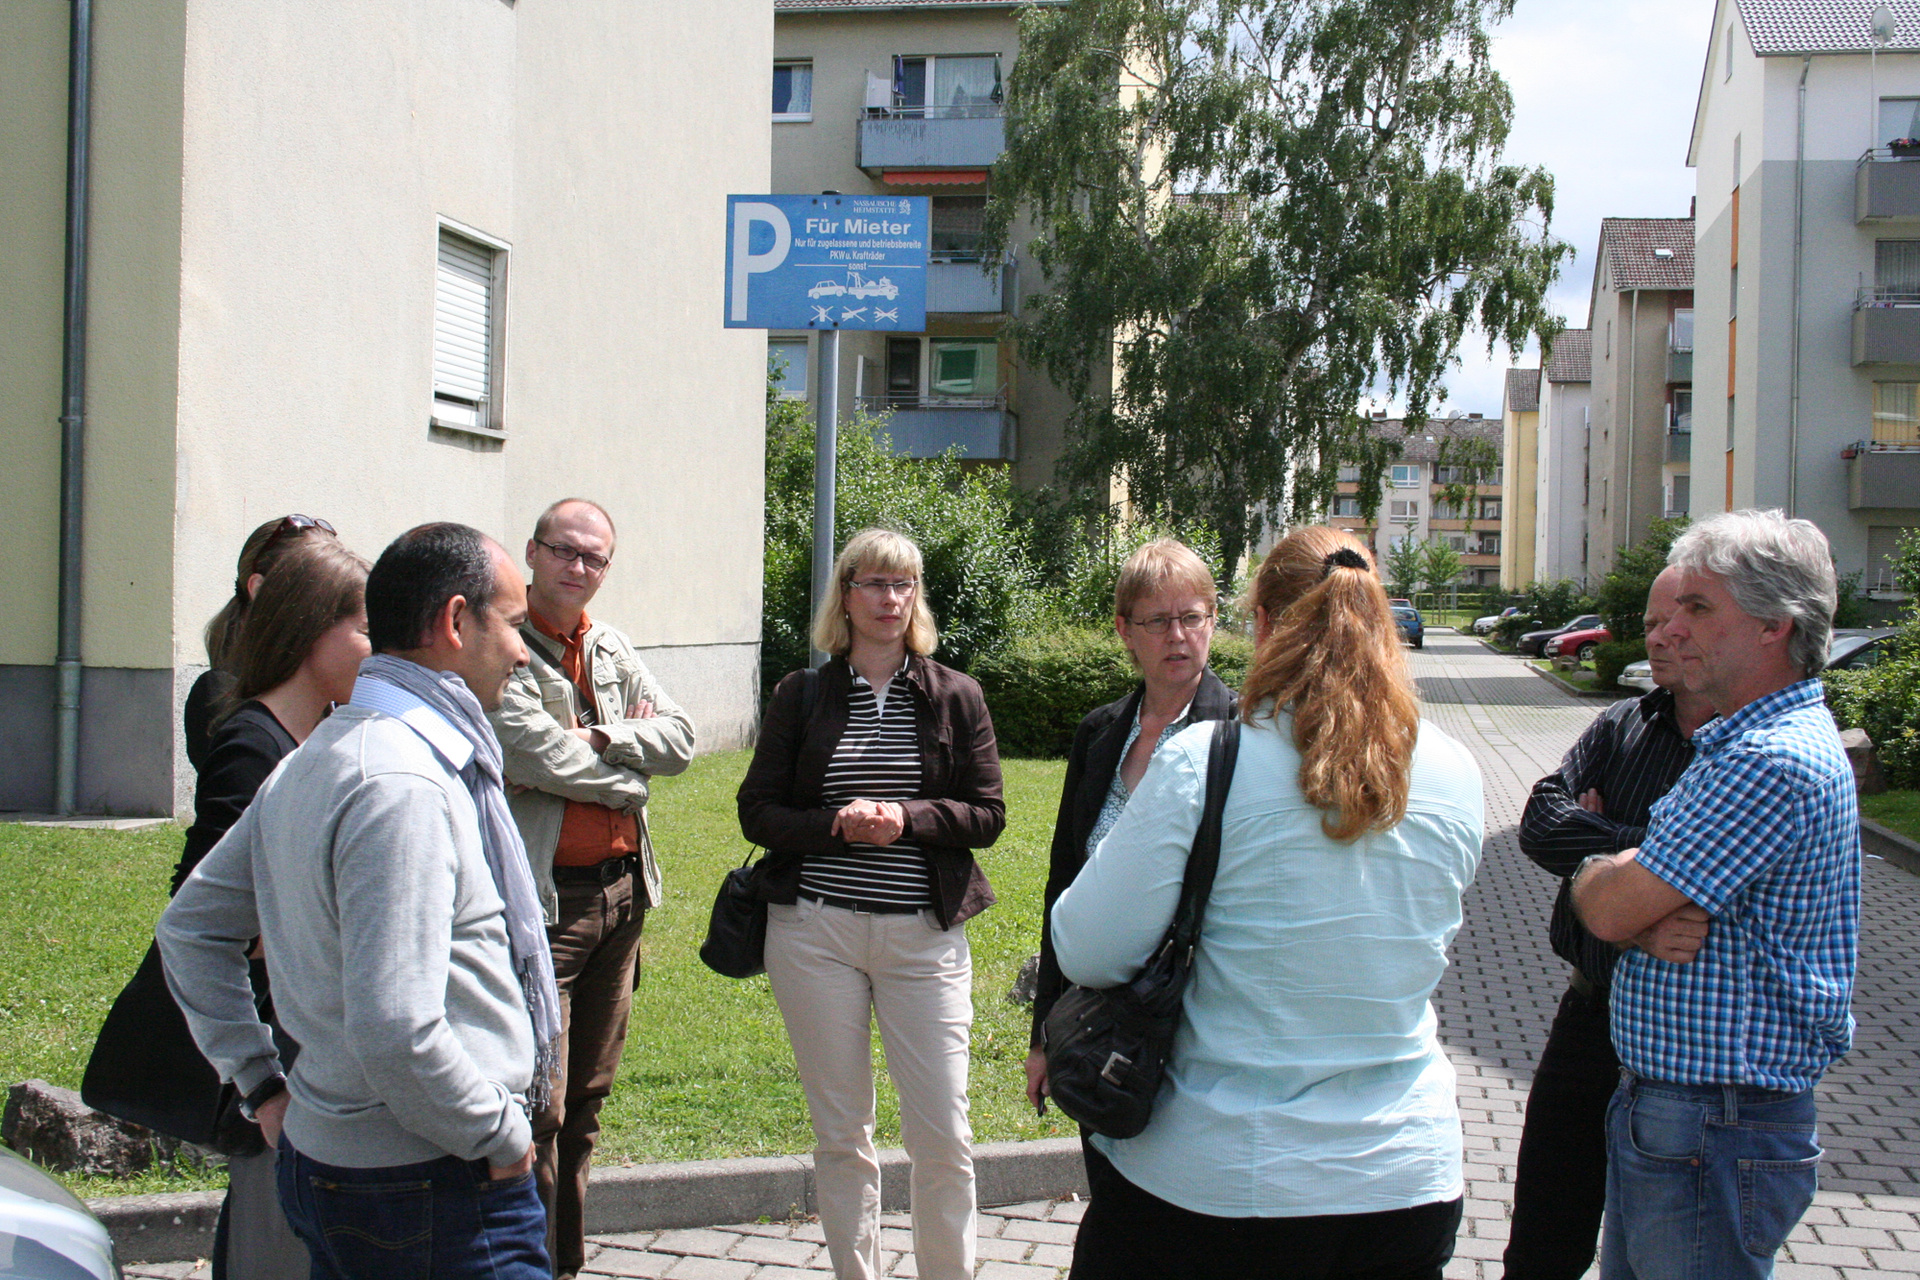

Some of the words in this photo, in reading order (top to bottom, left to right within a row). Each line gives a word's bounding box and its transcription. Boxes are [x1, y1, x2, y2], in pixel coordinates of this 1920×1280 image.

[806, 218, 839, 233] Für
[845, 219, 911, 235] Mieter
[795, 238, 806, 247] Nur
[807, 239, 816, 248] für
[818, 239, 857, 249] zugelassene
[859, 239, 871, 248] und
[872, 239, 921, 249] betriebsbereite
[731, 202, 791, 321] P
[830, 251, 845, 260] PKW
[853, 252, 885, 261] Krafträder
